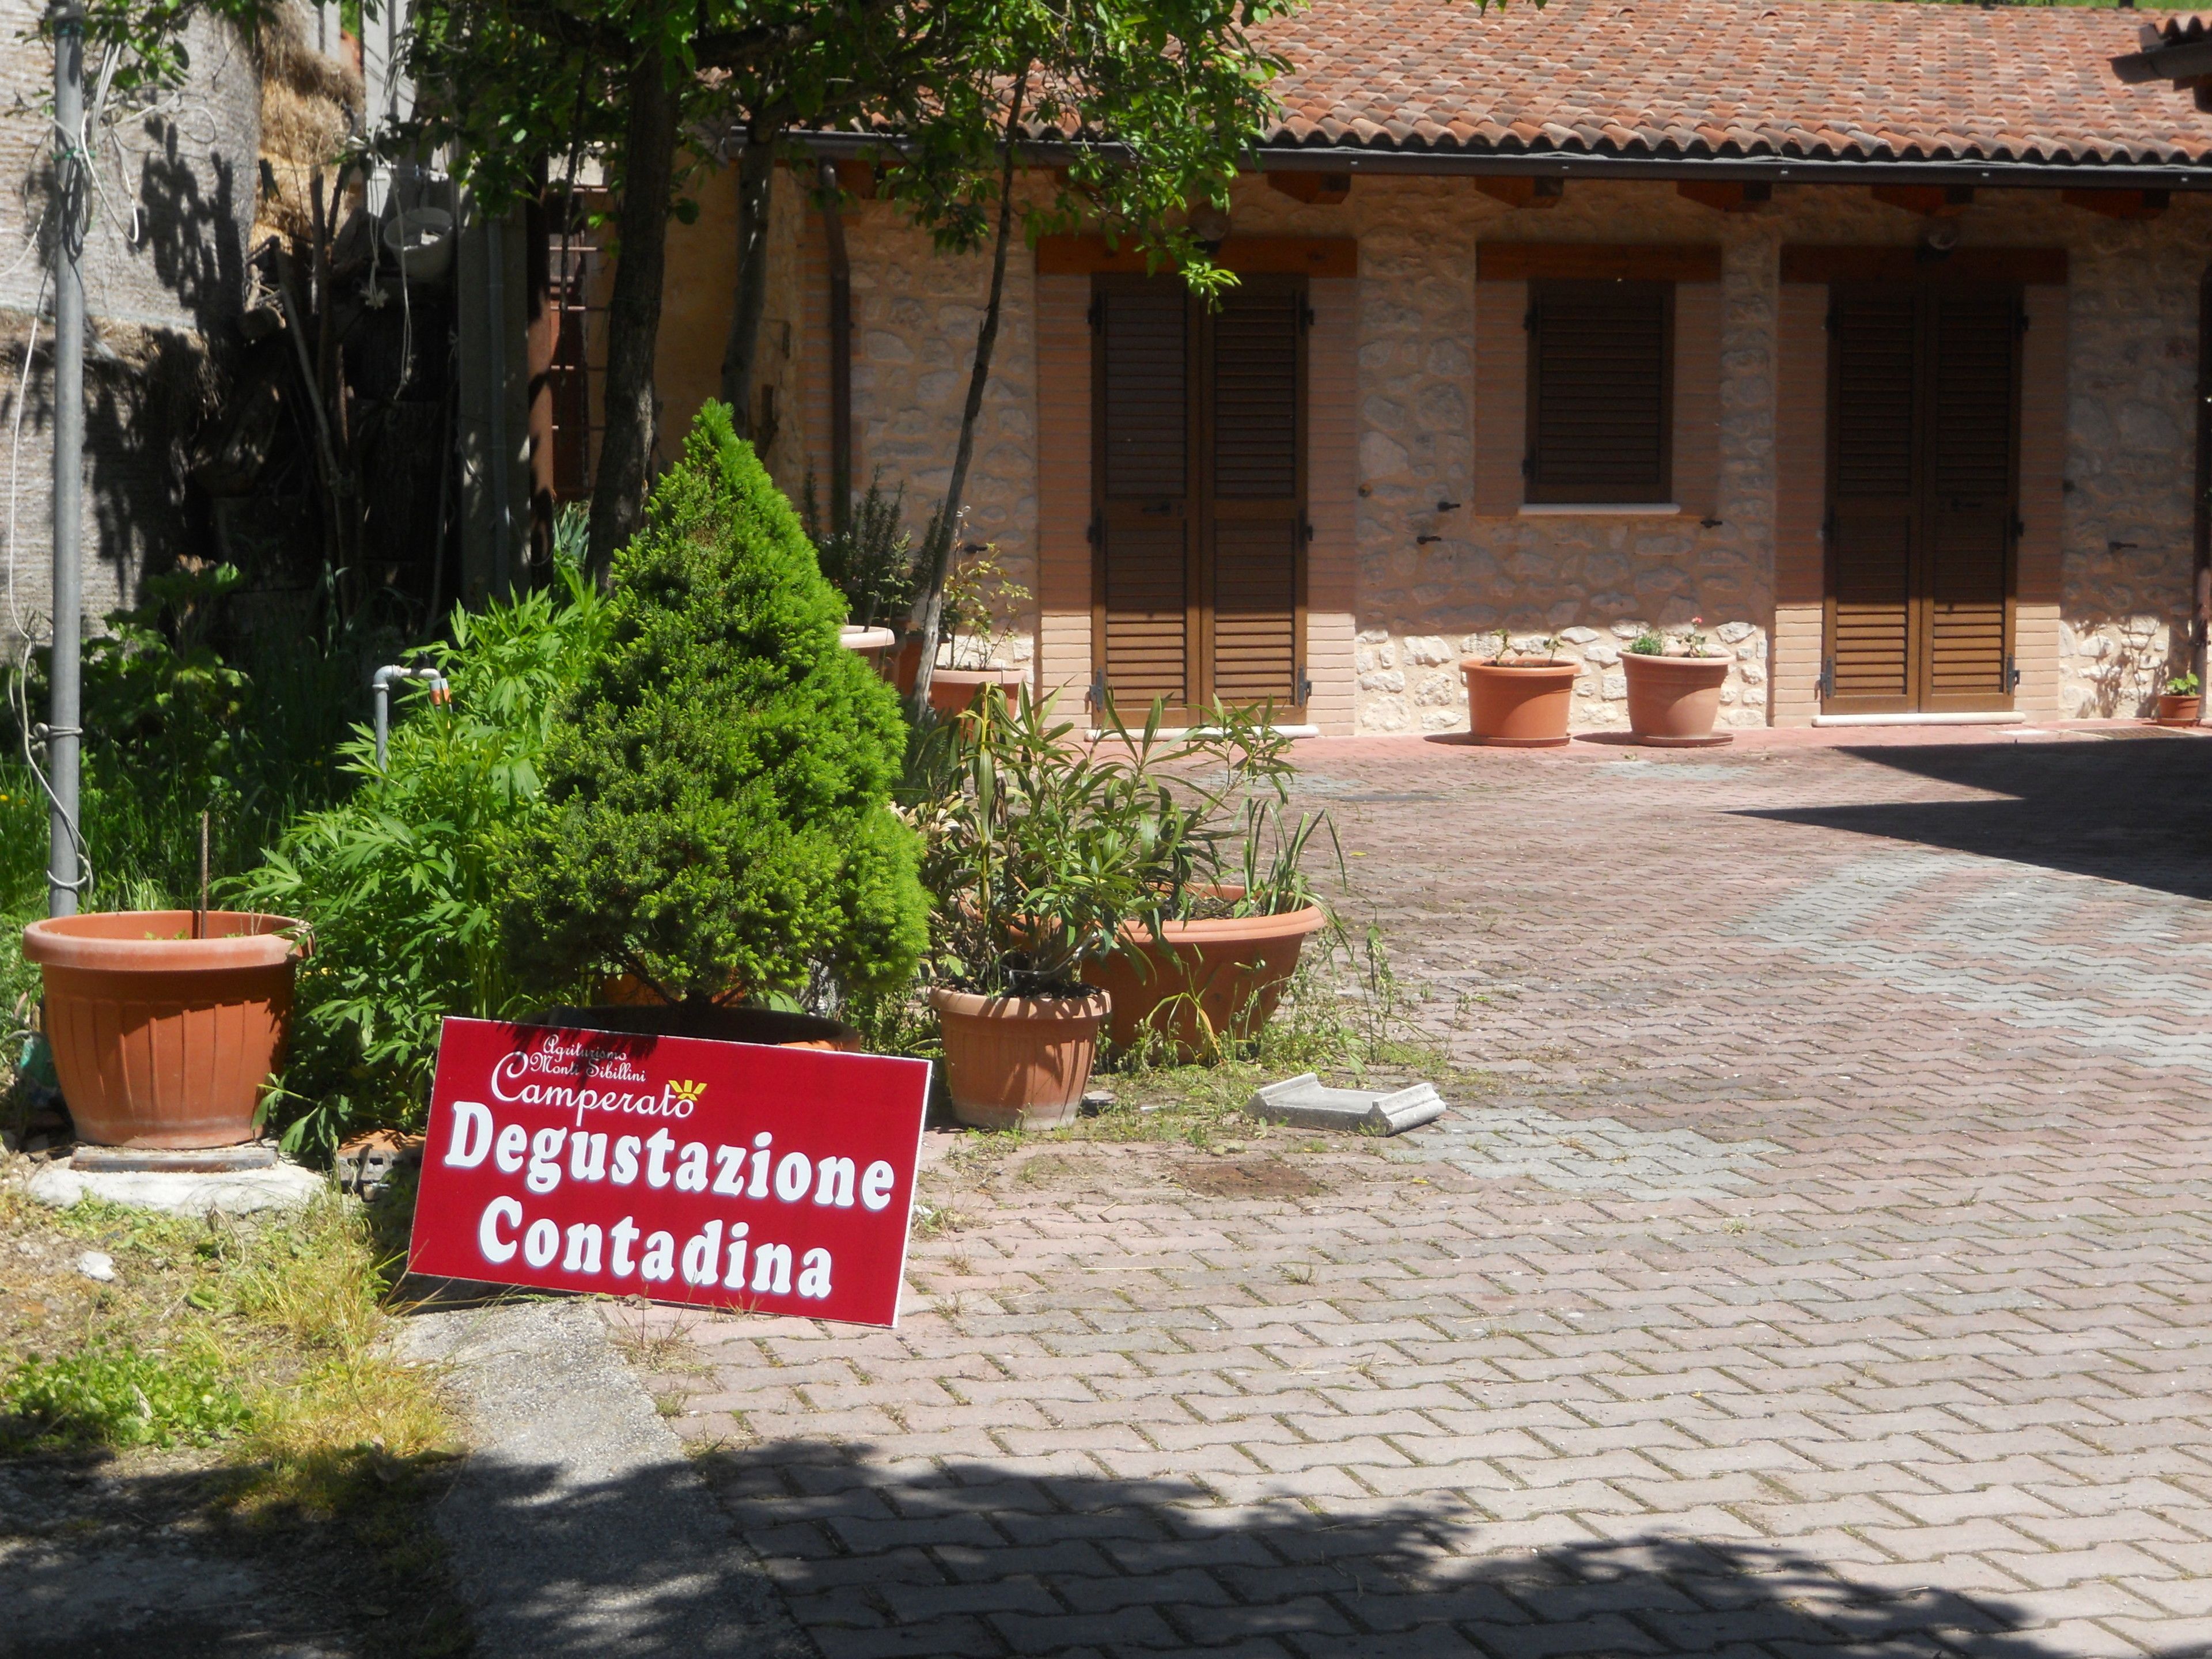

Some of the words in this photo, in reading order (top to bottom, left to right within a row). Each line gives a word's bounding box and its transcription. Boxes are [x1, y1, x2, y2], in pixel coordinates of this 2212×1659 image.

[529, 1051, 579, 1075] Monti
[586, 1058, 646, 1082] Sibillini
[543, 1034, 627, 1062] Agriturismo
[491, 1051, 695, 1127] Camperato
[444, 1100, 896, 1211] Degustazione
[479, 1195, 833, 1300] Contadina
